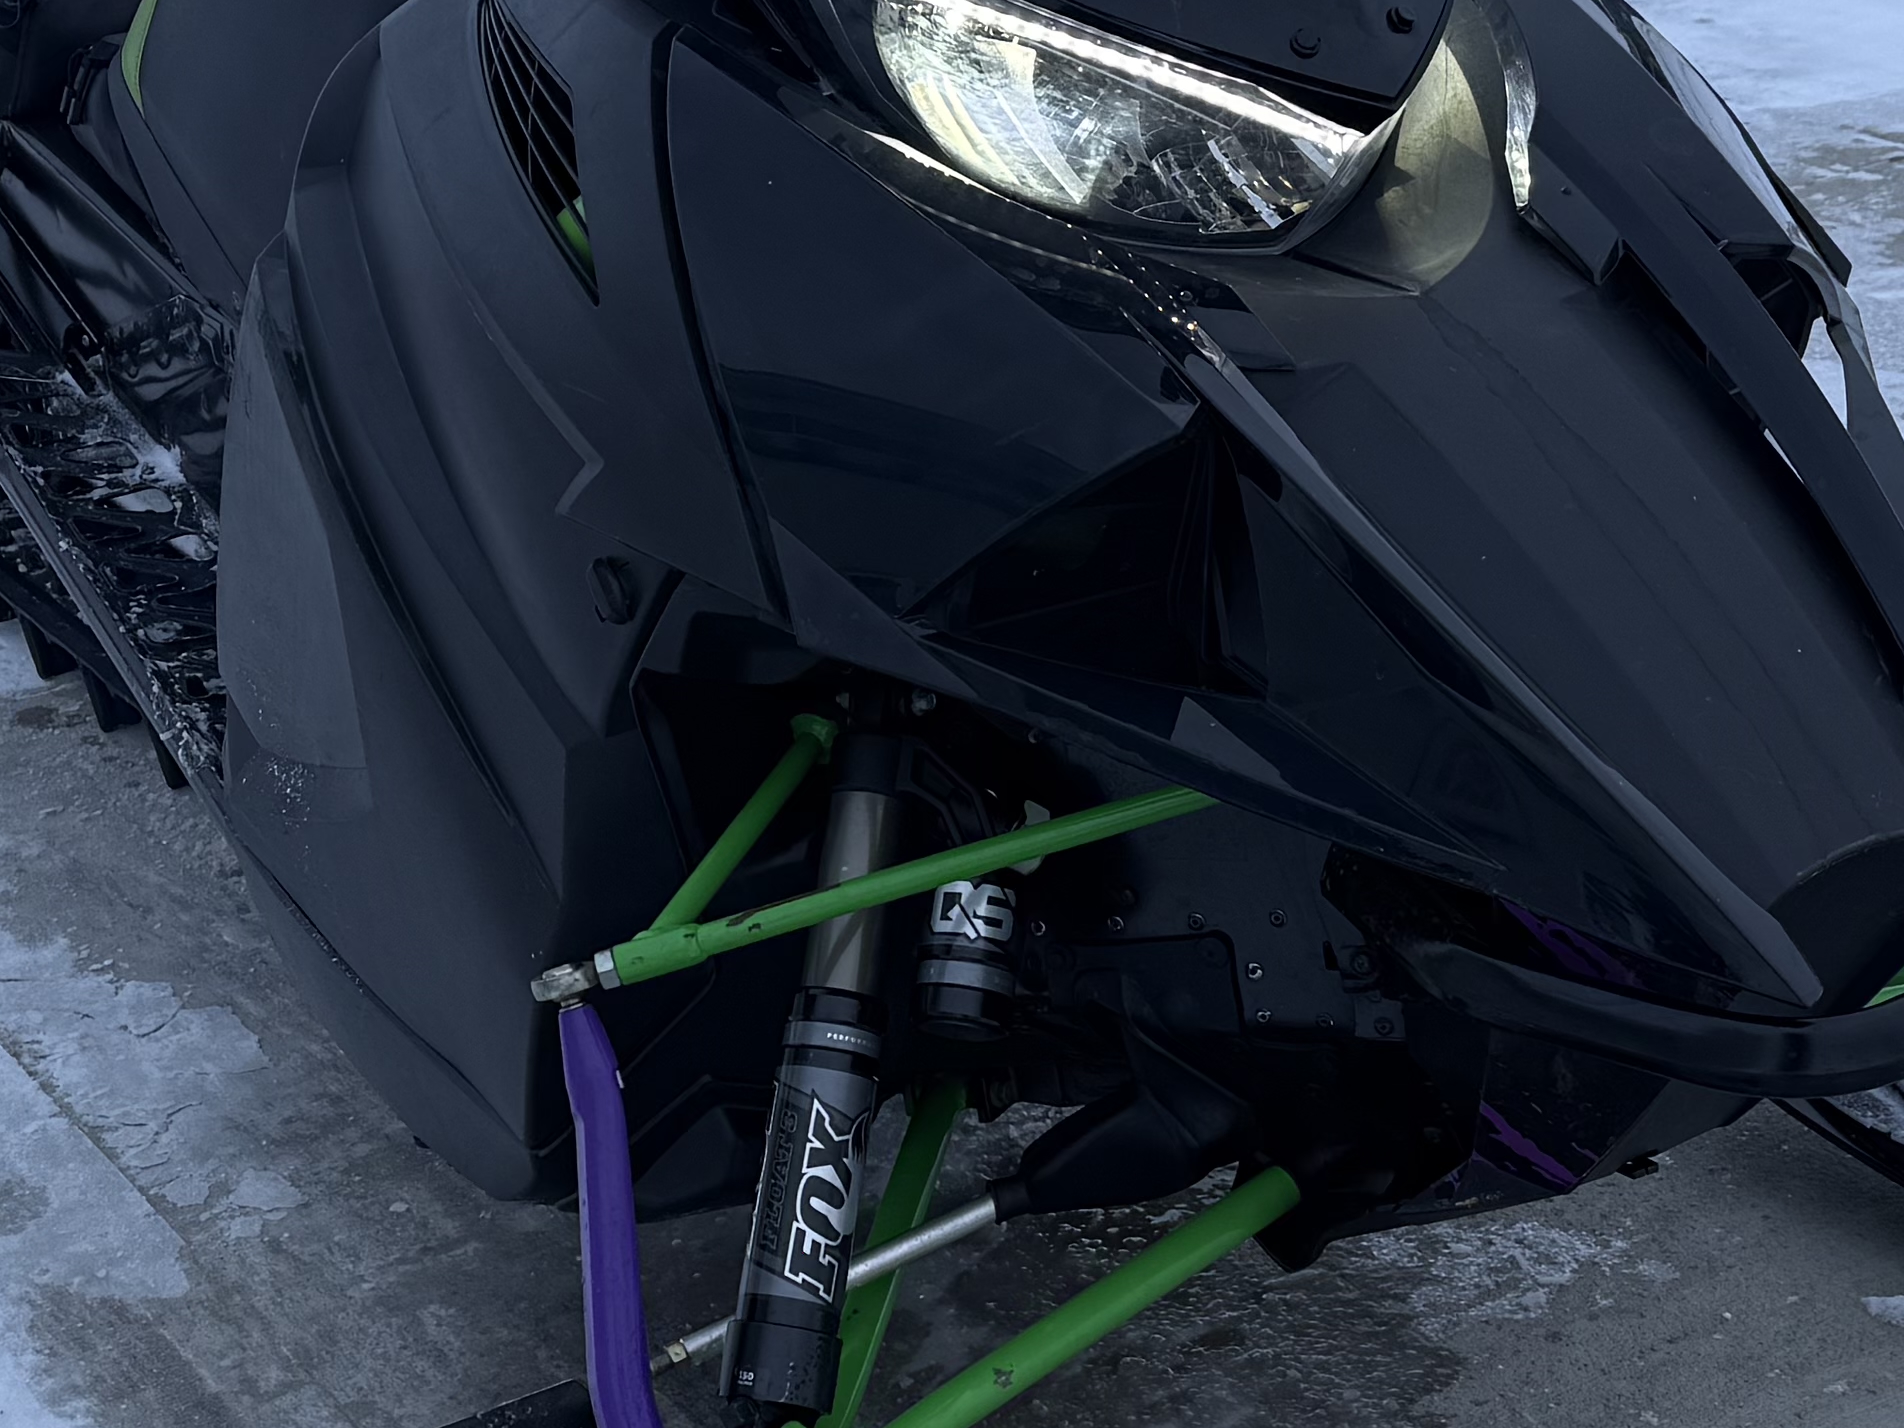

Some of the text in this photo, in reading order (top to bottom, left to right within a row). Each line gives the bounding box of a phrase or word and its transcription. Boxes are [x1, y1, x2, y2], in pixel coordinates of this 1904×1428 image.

[930, 880, 1015, 942] QS
[760, 1133, 795, 1252] FLOAT
[784, 1097, 864, 1305] FOX
